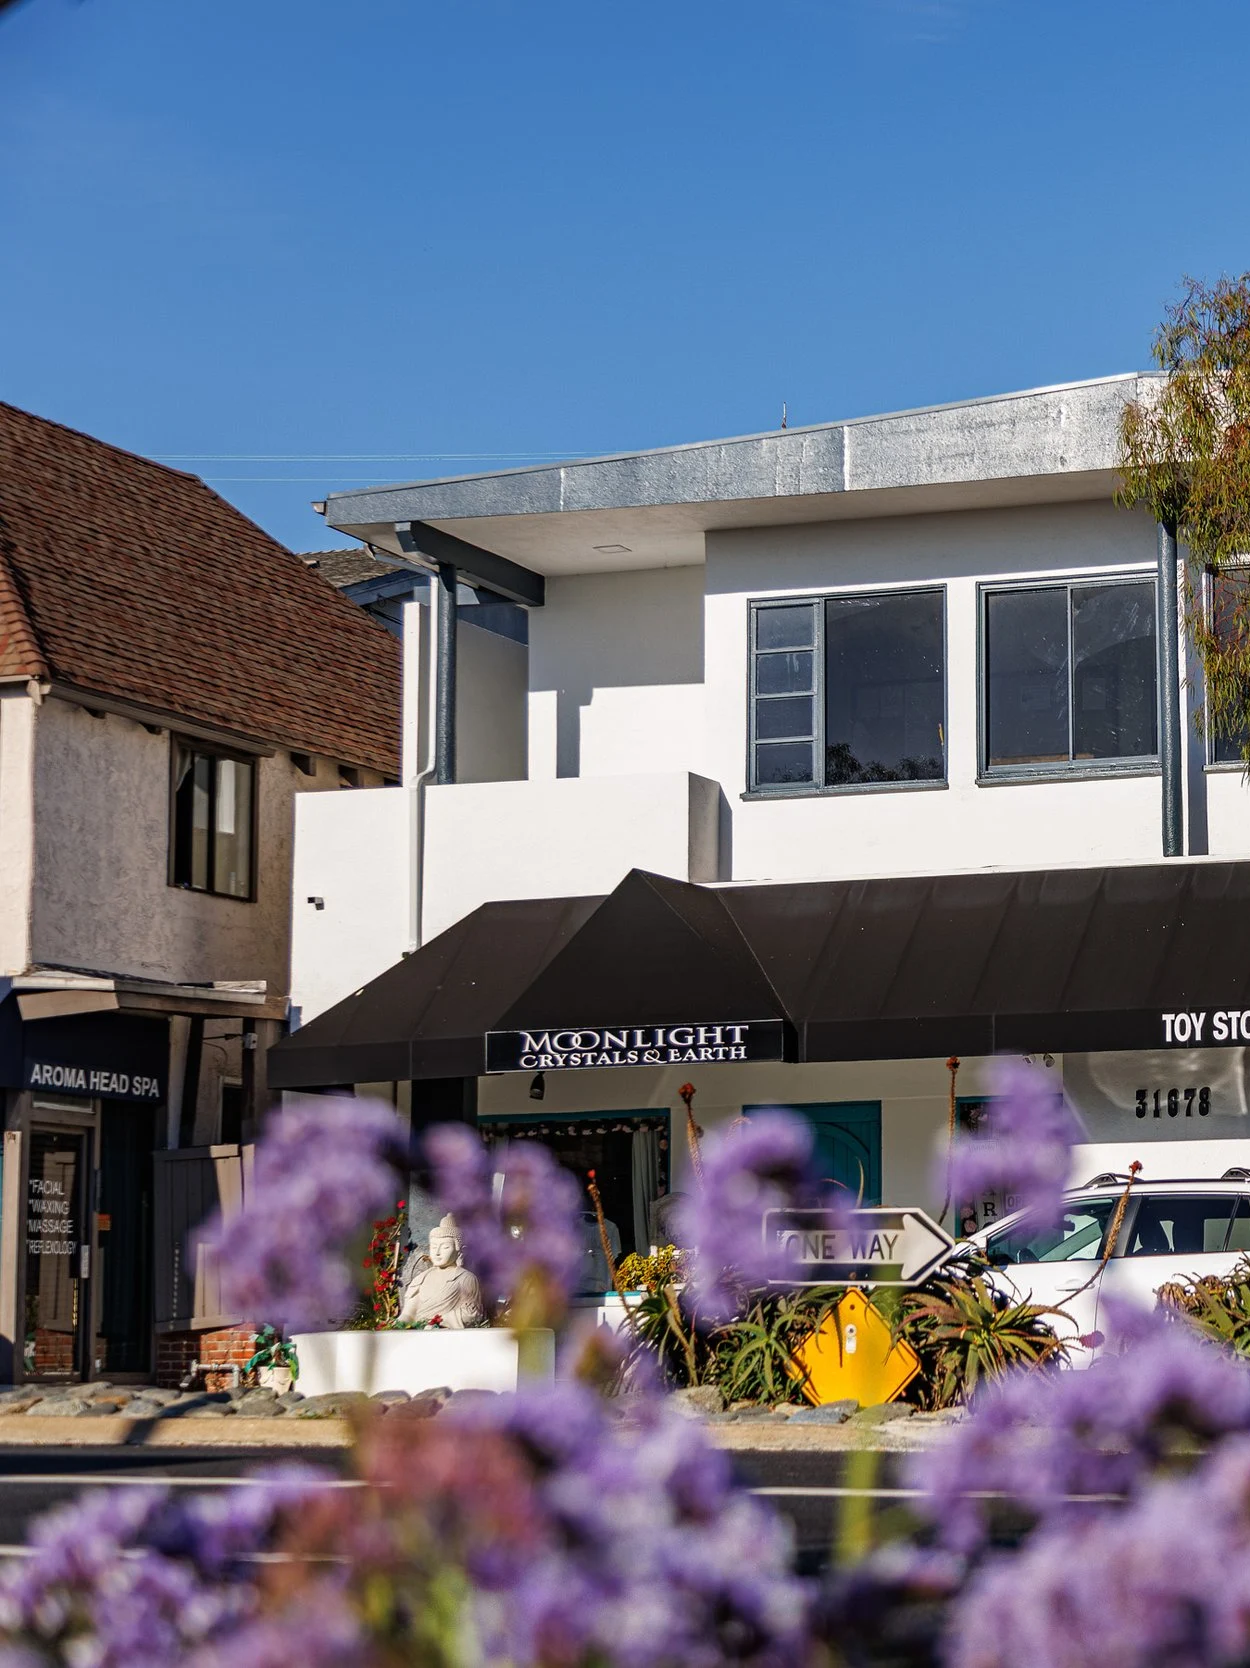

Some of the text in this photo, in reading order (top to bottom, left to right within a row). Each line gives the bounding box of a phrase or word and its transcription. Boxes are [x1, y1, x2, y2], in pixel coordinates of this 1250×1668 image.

[519, 1024, 749, 1055] MOONLIGHT
[1162, 1012, 1206, 1042] TOY
[519, 1046, 748, 1069] CRYSTALS & EARTH
[30, 1064, 160, 1098] AROMA HEAD SPA
[1135, 1086, 1212, 1119] 31678
[785, 1234, 898, 1260] ONE WAY
